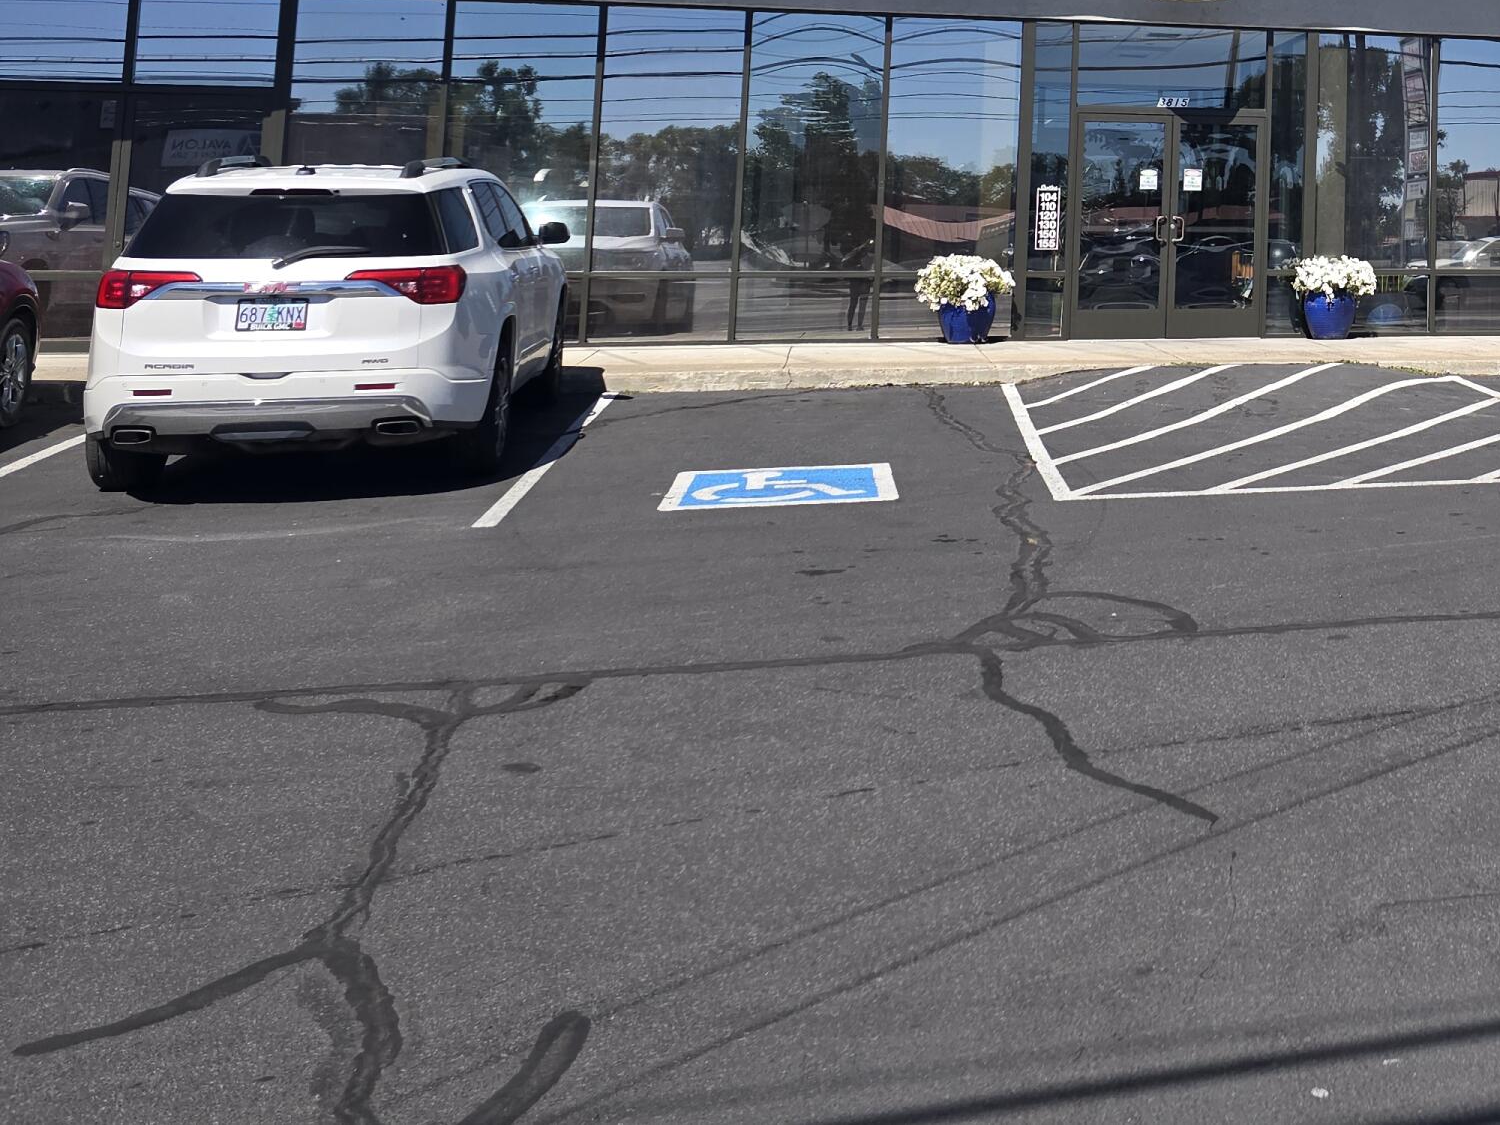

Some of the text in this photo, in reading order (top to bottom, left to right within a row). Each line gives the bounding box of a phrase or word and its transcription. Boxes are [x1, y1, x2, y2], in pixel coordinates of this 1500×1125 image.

[1159, 98, 1189, 107] 3815
[1040, 192, 1057, 201] 104
[1040, 202, 1056, 211] 110
[1039, 211, 1057, 220] 120
[1039, 221, 1056, 229] 130
[1038, 230, 1056, 238] 150
[1038, 239, 1055, 248] 155
[240, 306, 304, 323] 687 KNX
